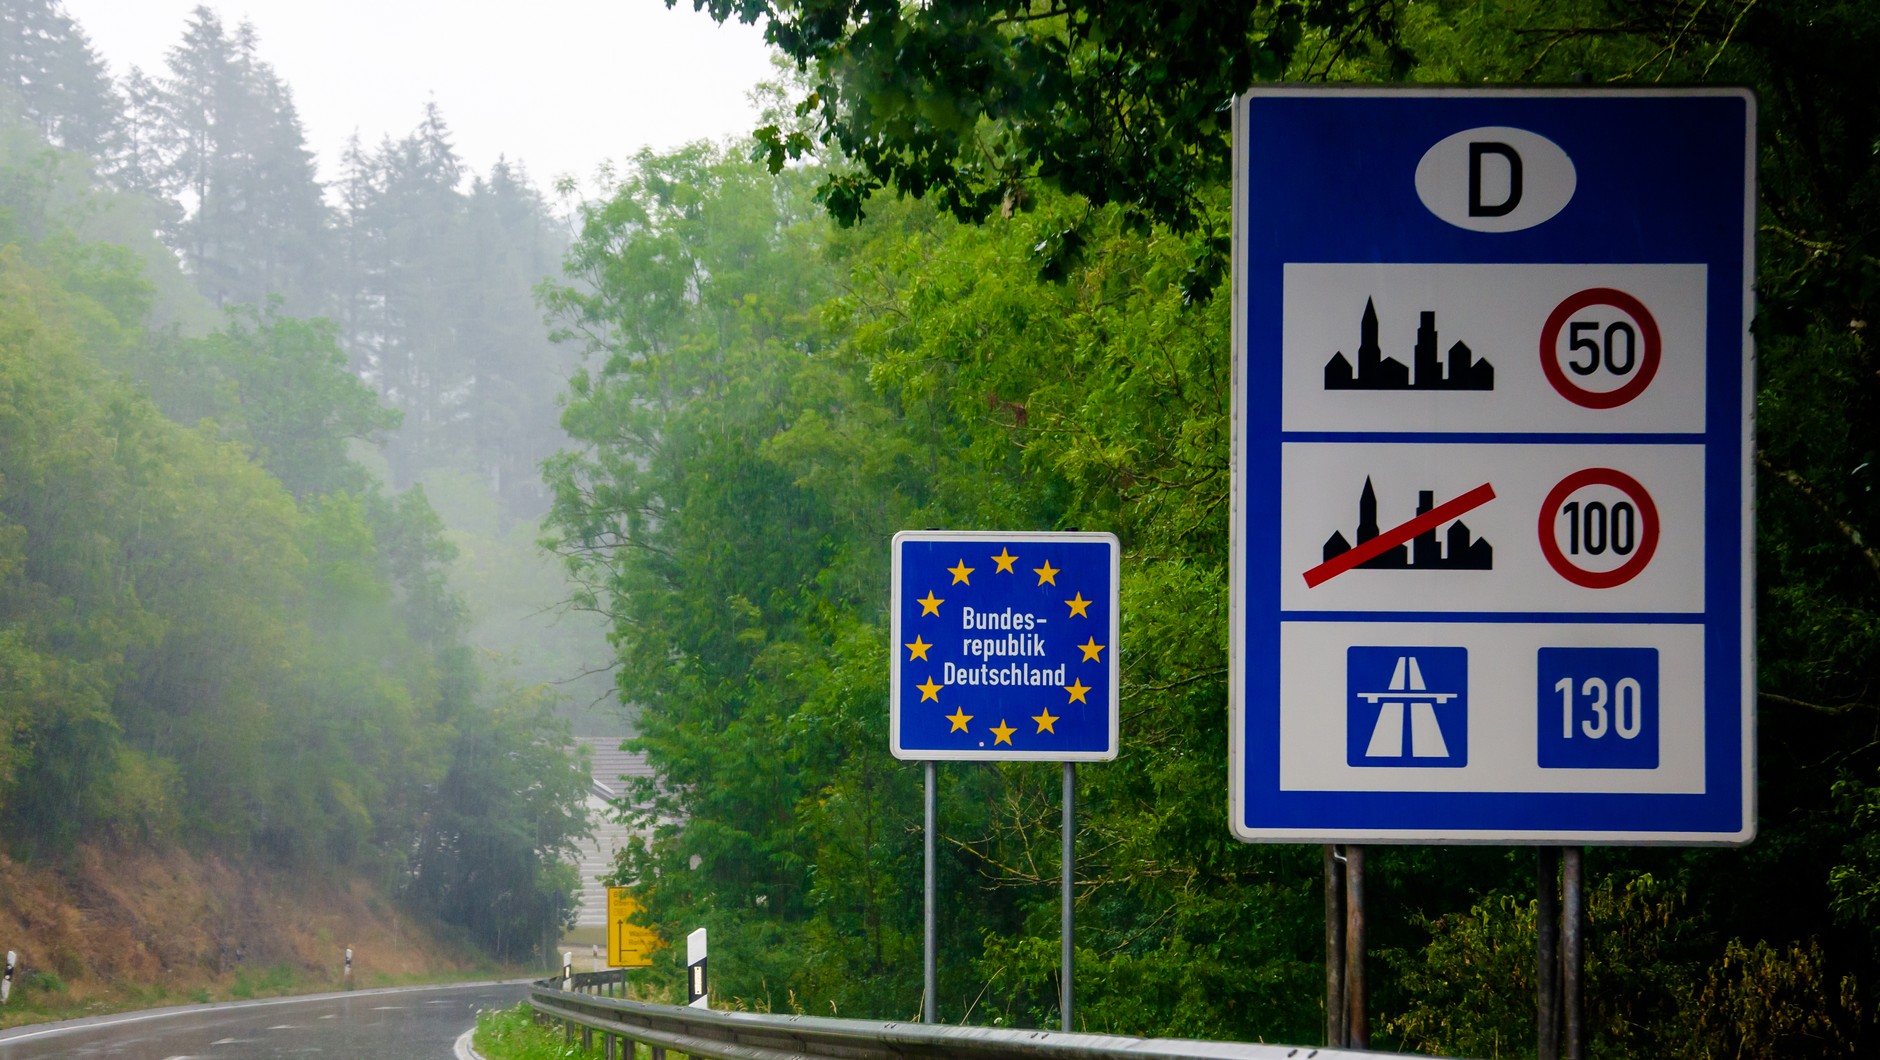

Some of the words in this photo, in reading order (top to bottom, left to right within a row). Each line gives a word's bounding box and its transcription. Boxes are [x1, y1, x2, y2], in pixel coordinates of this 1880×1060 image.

[1468, 141, 1523, 218] D
[1568, 321, 1636, 376] 50
[1562, 501, 1635, 556] 100
[963, 606, 1047, 630] Bundes-
[944, 662, 1065, 686] Deutschland
[963, 633, 1045, 661] republik
[1554, 676, 1642, 740] 130
